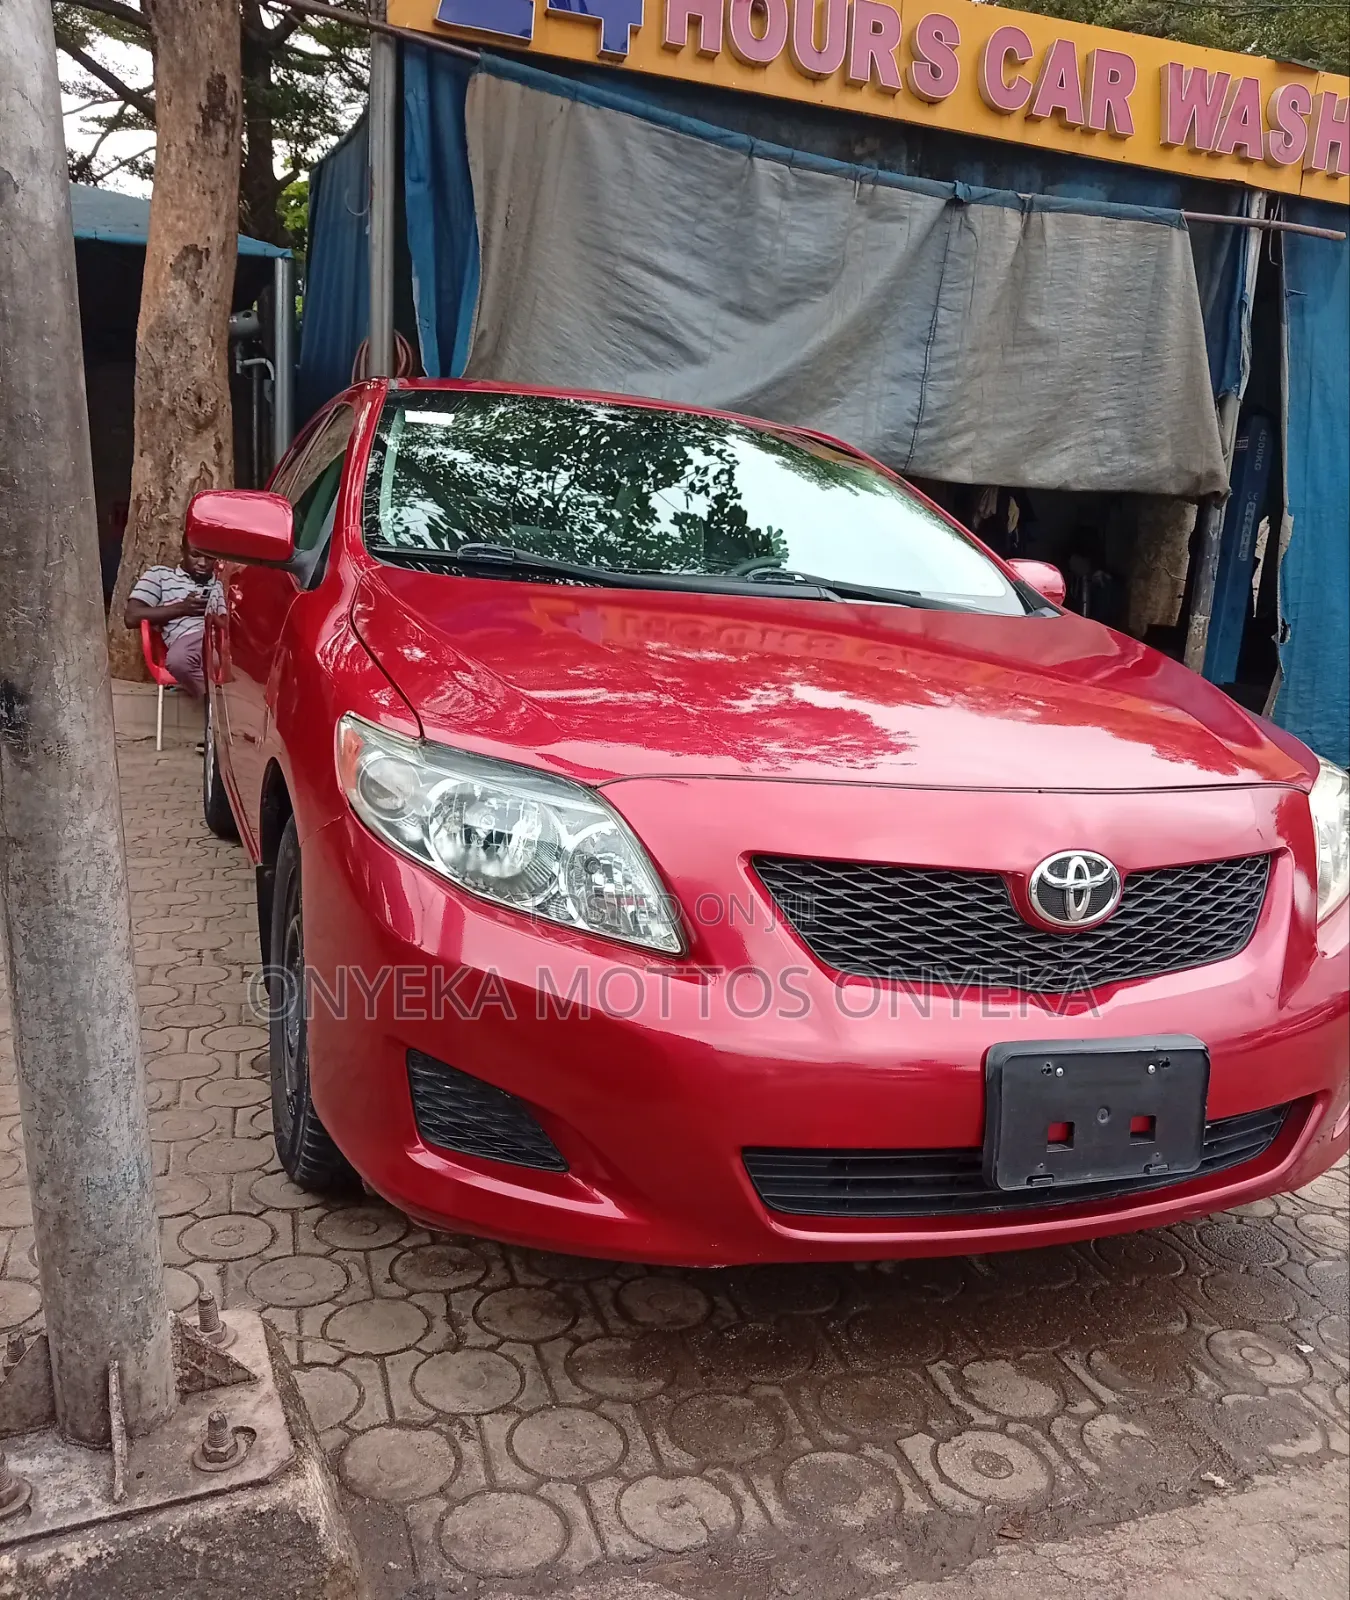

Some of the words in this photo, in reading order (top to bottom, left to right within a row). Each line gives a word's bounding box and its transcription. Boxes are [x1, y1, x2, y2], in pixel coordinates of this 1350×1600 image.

[663, 0, 961, 103] HOURS
[979, 25, 1138, 140] CAR
[1160, 62, 1350, 178] WASH
